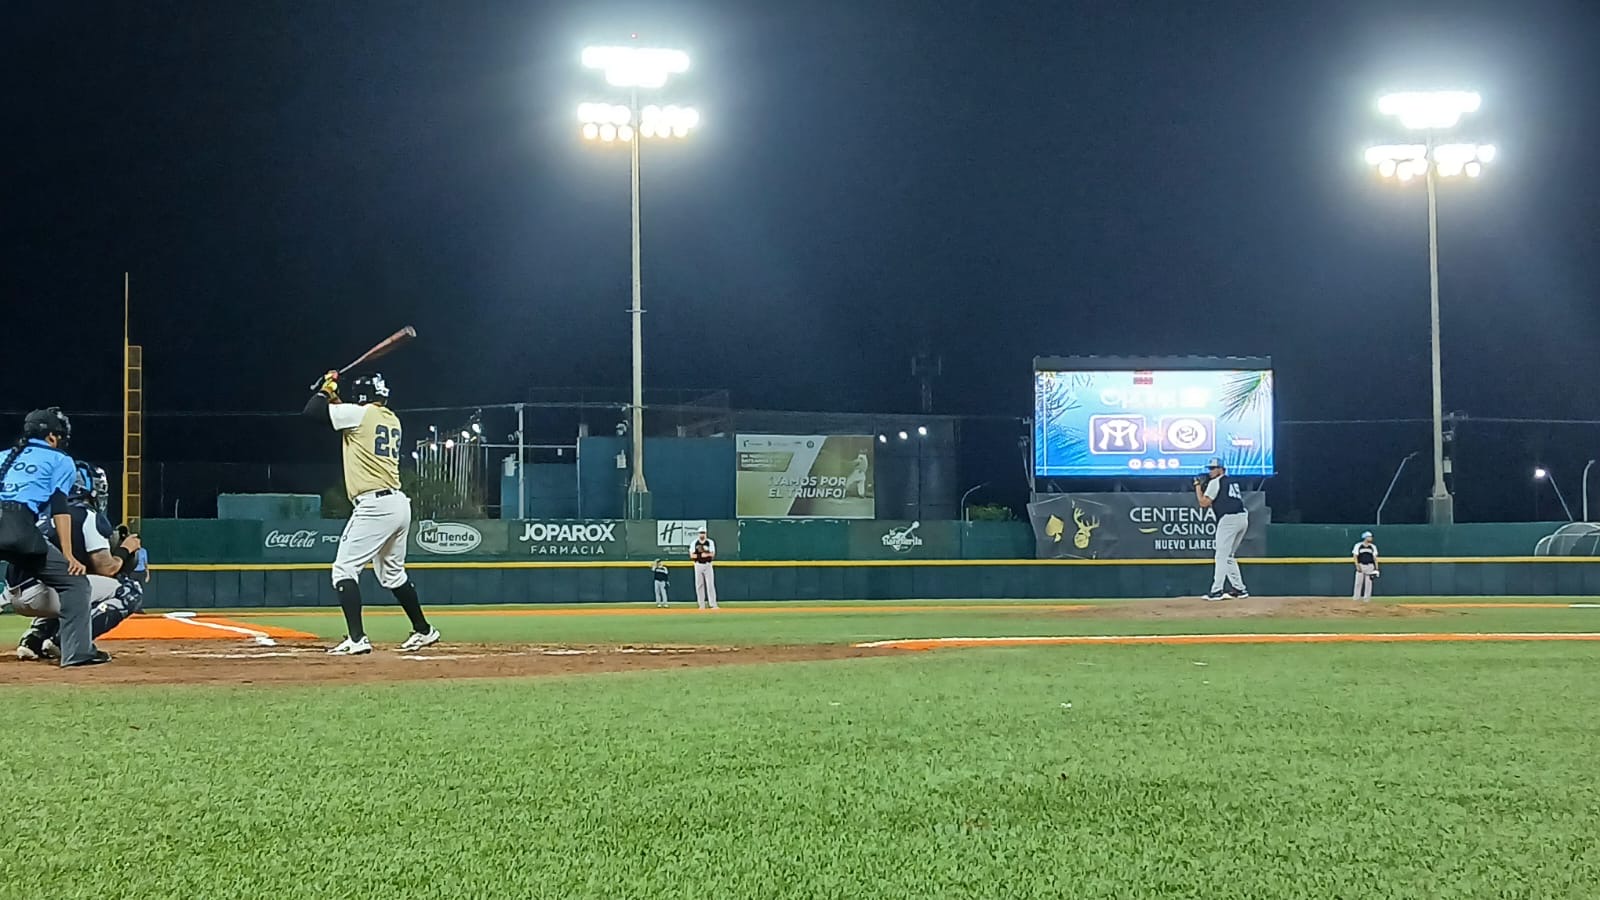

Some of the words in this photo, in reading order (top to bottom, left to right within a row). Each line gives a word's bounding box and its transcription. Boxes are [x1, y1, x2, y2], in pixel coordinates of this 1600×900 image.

[375, 425, 401, 458] 23
[820, 476, 847, 487] POR
[768, 488, 785, 498] EL
[1129, 507, 1217, 522] CENTENA
[519, 523, 616, 542] JOPAROX
[1162, 523, 1216, 535] CASINO
[530, 545, 605, 555] FARMACIA
[1155, 540, 1186, 550] NUEVO
[1188, 540, 1217, 550] LARED
